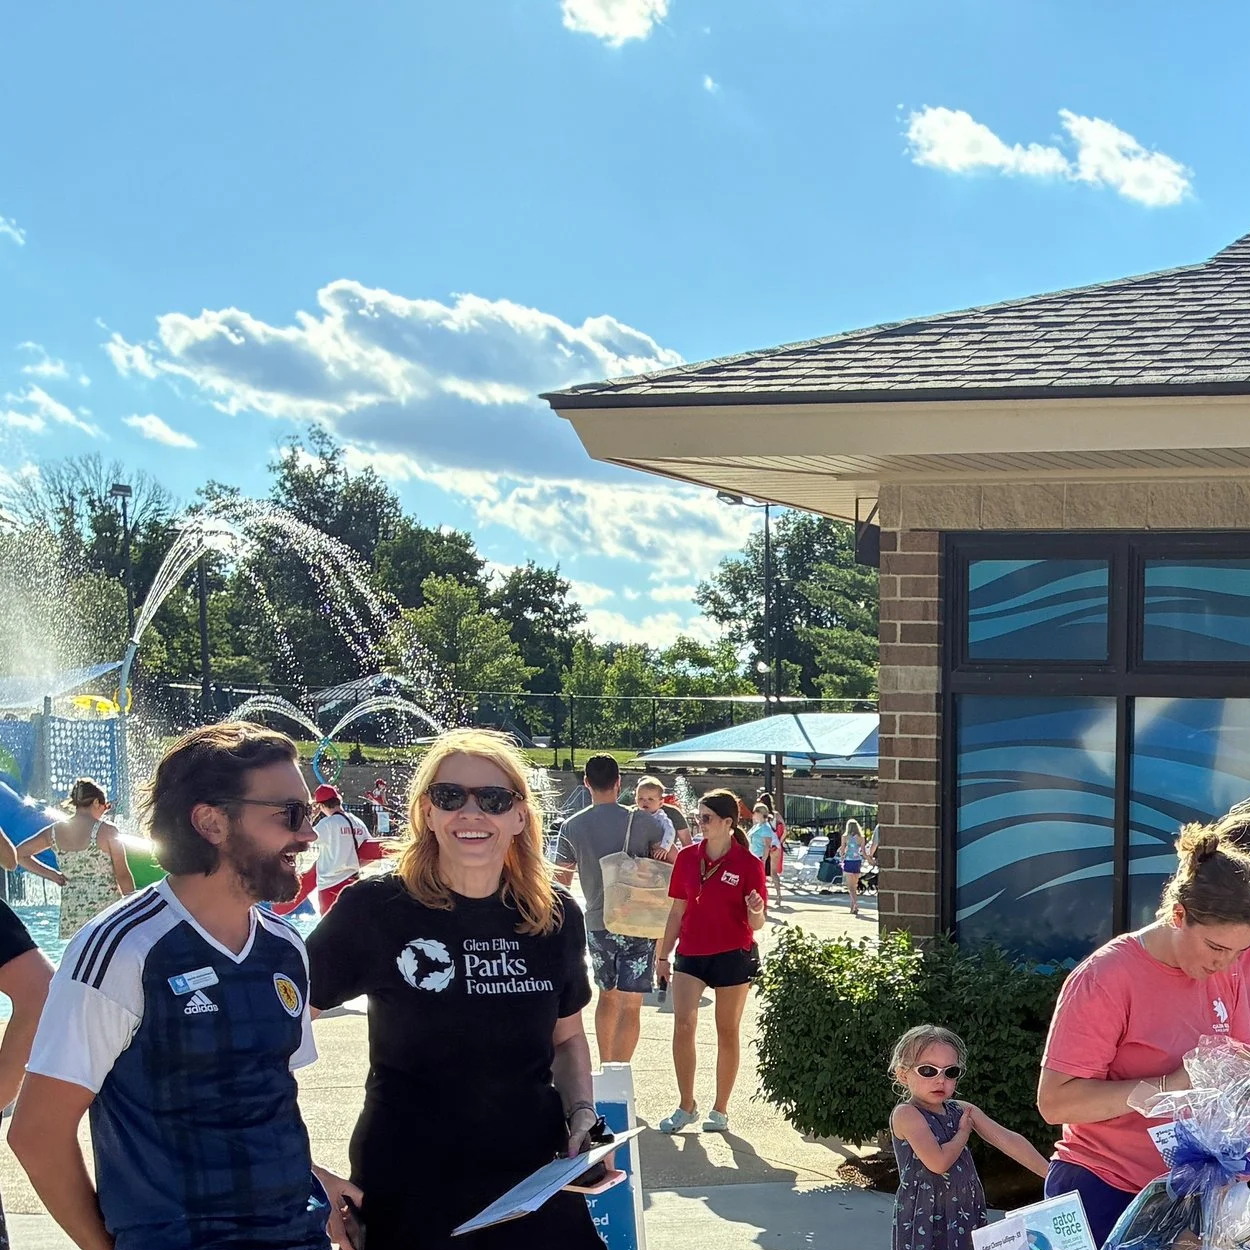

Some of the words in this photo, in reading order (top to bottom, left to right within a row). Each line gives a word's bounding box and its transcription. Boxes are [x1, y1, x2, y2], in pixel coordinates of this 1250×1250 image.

[463, 939, 489, 951] Glen
[492, 938, 519, 953] Ellyn
[463, 953, 527, 977] Parks
[466, 977, 553, 995] Foundation
[184, 1003, 219, 1015] adidas
[1053, 1211, 1076, 1235] gator
[1062, 1223, 1082, 1237] race
